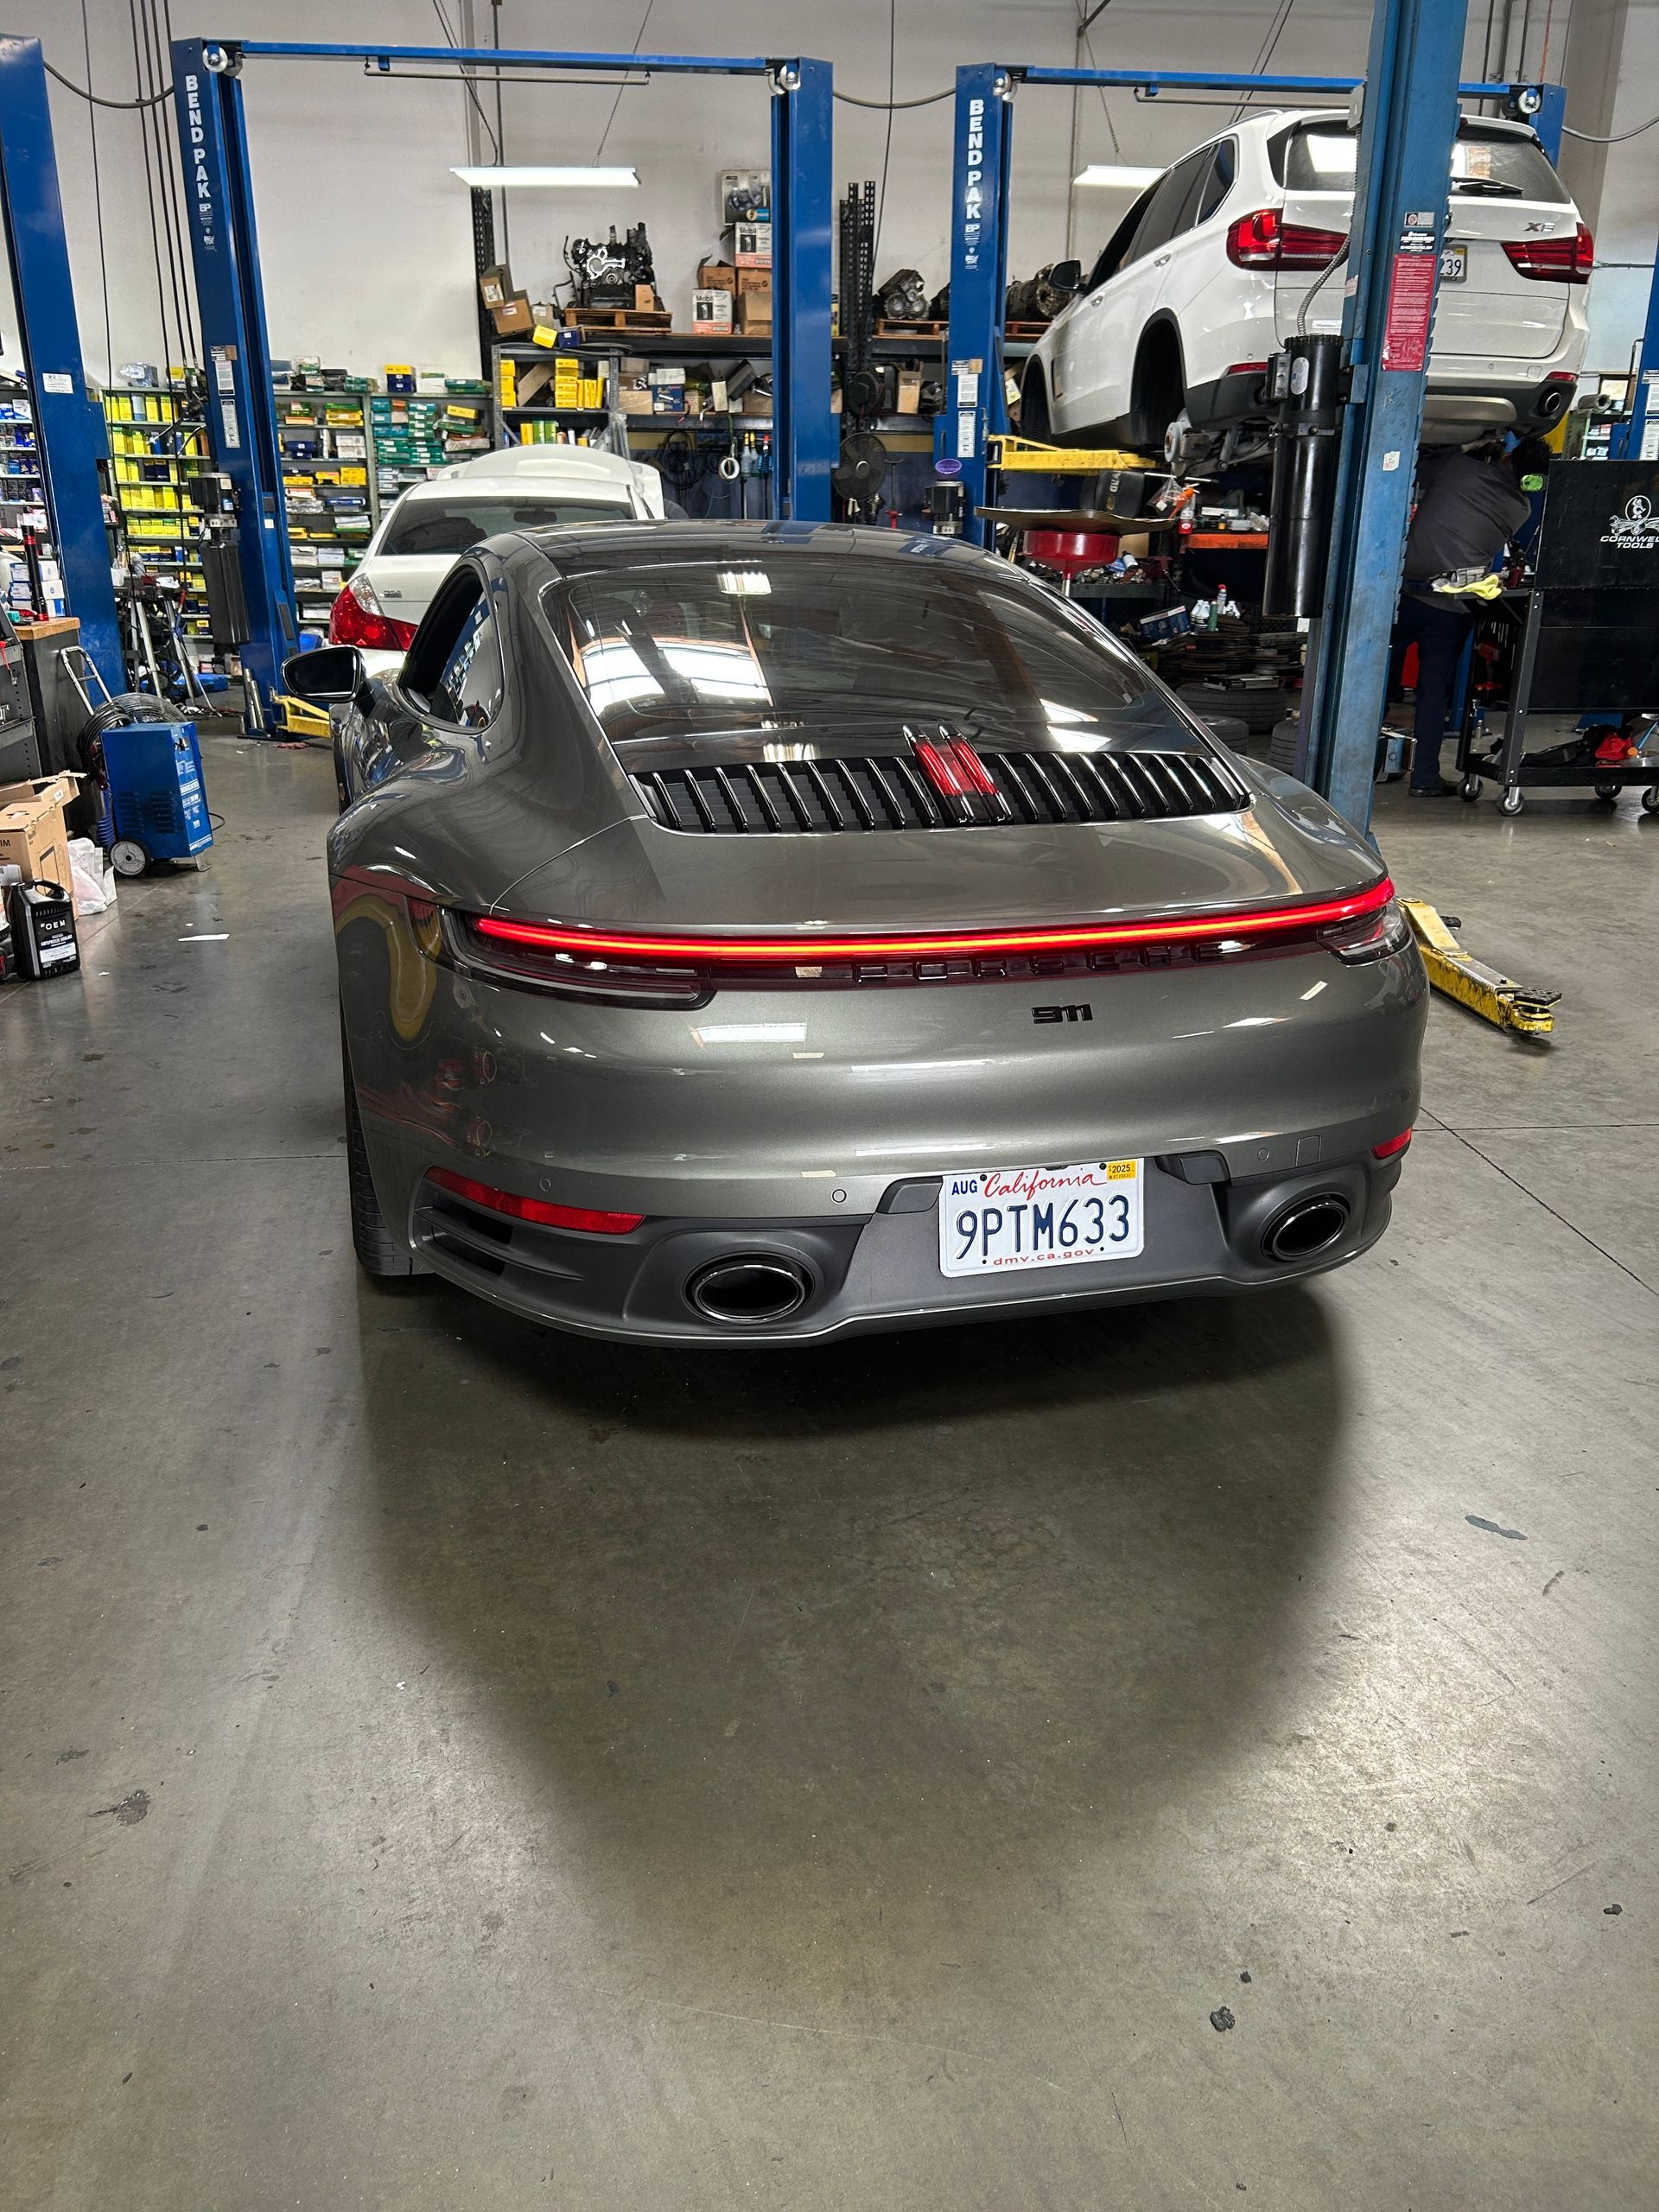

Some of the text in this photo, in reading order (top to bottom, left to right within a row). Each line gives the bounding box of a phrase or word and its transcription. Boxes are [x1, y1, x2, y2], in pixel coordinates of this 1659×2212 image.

[185, 74, 204, 143] BEND
[968, 99, 985, 166] BEND
[193, 148, 212, 199] PAK
[965, 170, 983, 219] PAK
[45, 919, 67, 931] OEM
[853, 942, 1224, 983] PORSCHE
[1031, 1003, 1094, 1025] 911
[983, 1170, 1108, 1201] California
[1111, 1163, 1131, 1173] 2025
[951, 1179, 978, 1196] AUG
[956, 1194, 1129, 1260] 9PTM633
[993, 1249, 1095, 1267] dmv.ca.gov
